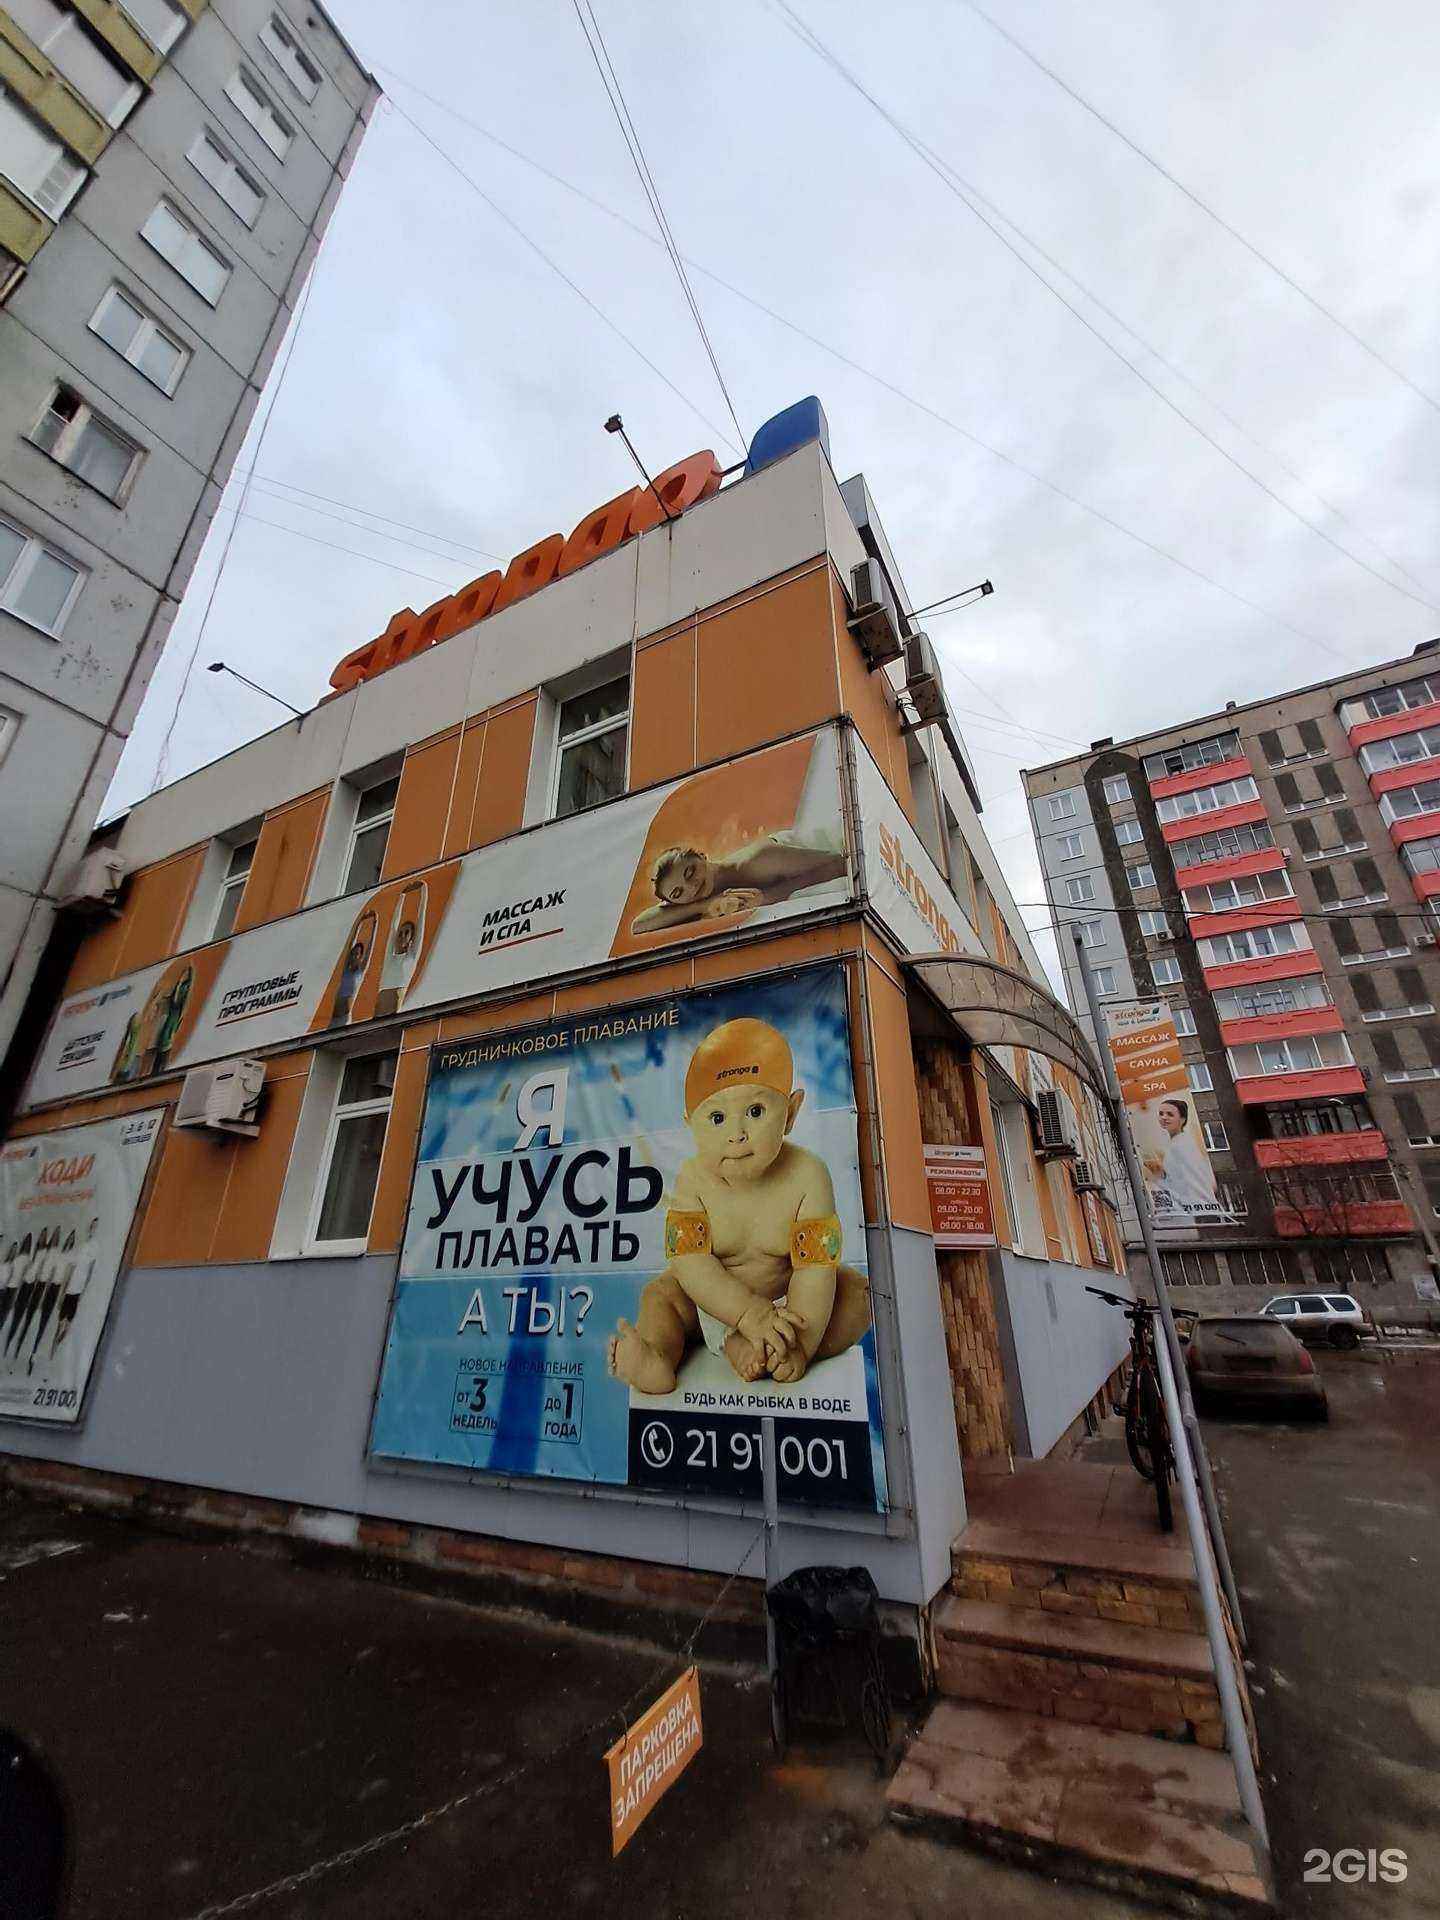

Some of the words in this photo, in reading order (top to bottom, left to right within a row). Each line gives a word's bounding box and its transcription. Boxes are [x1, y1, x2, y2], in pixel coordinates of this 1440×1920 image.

[482, 888, 567, 927] МАССАЖ
[480, 929, 495, 946] И
[496, 918, 531, 941] СПА
[217, 985, 303, 1020] ПРОГРАММЫ
[222, 970, 300, 1004] ГРУППОВЫЕ
[440, 1032, 569, 1069] ГРУДНИЧКОВОЕ
[573, 1008, 680, 1045] ПЛАВАНИЕ
[1116, 1033, 1170, 1046] МАССАЖ
[1129, 1057, 1169, 1069] САУНА
[1143, 1082, 1167, 1092] SPA
[514, 1066, 570, 1152] Я
[37, 1153, 96, 1185] ХОДИ
[426, 1145, 665, 1230] УЧУСЬ
[435, 1219, 641, 1270] ПЛАВАТЬ
[457, 1287, 490, 1337] А
[502, 1284, 594, 1338] ТЫ?
[459, 1357, 497, 1372] НОВОЕ
[456, 1391, 469, 1404] от
[469, 1377, 489, 1412] 3
[562, 1382, 574, 1420] 1
[684, 1392, 716, 1406] БУДЬ
[719, 1394, 744, 1407] КАК
[748, 1396, 795, 1410] РЫБКА
[799, 1397, 808, 1410] В
[812, 1398, 852, 1413] ВОДЕ
[453, 1414, 498, 1430] НЕДЕЛЬ
[544, 1421, 578, 1438] ГОДА
[686, 1429, 717, 1468] 21
[729, 1432, 764, 1471] 91
[780, 1436, 848, 1479] 001
[619, 1692, 693, 1786] ПАРКОВКА
[615, 1716, 700, 1828] ЗАПРЕЩЕНА
